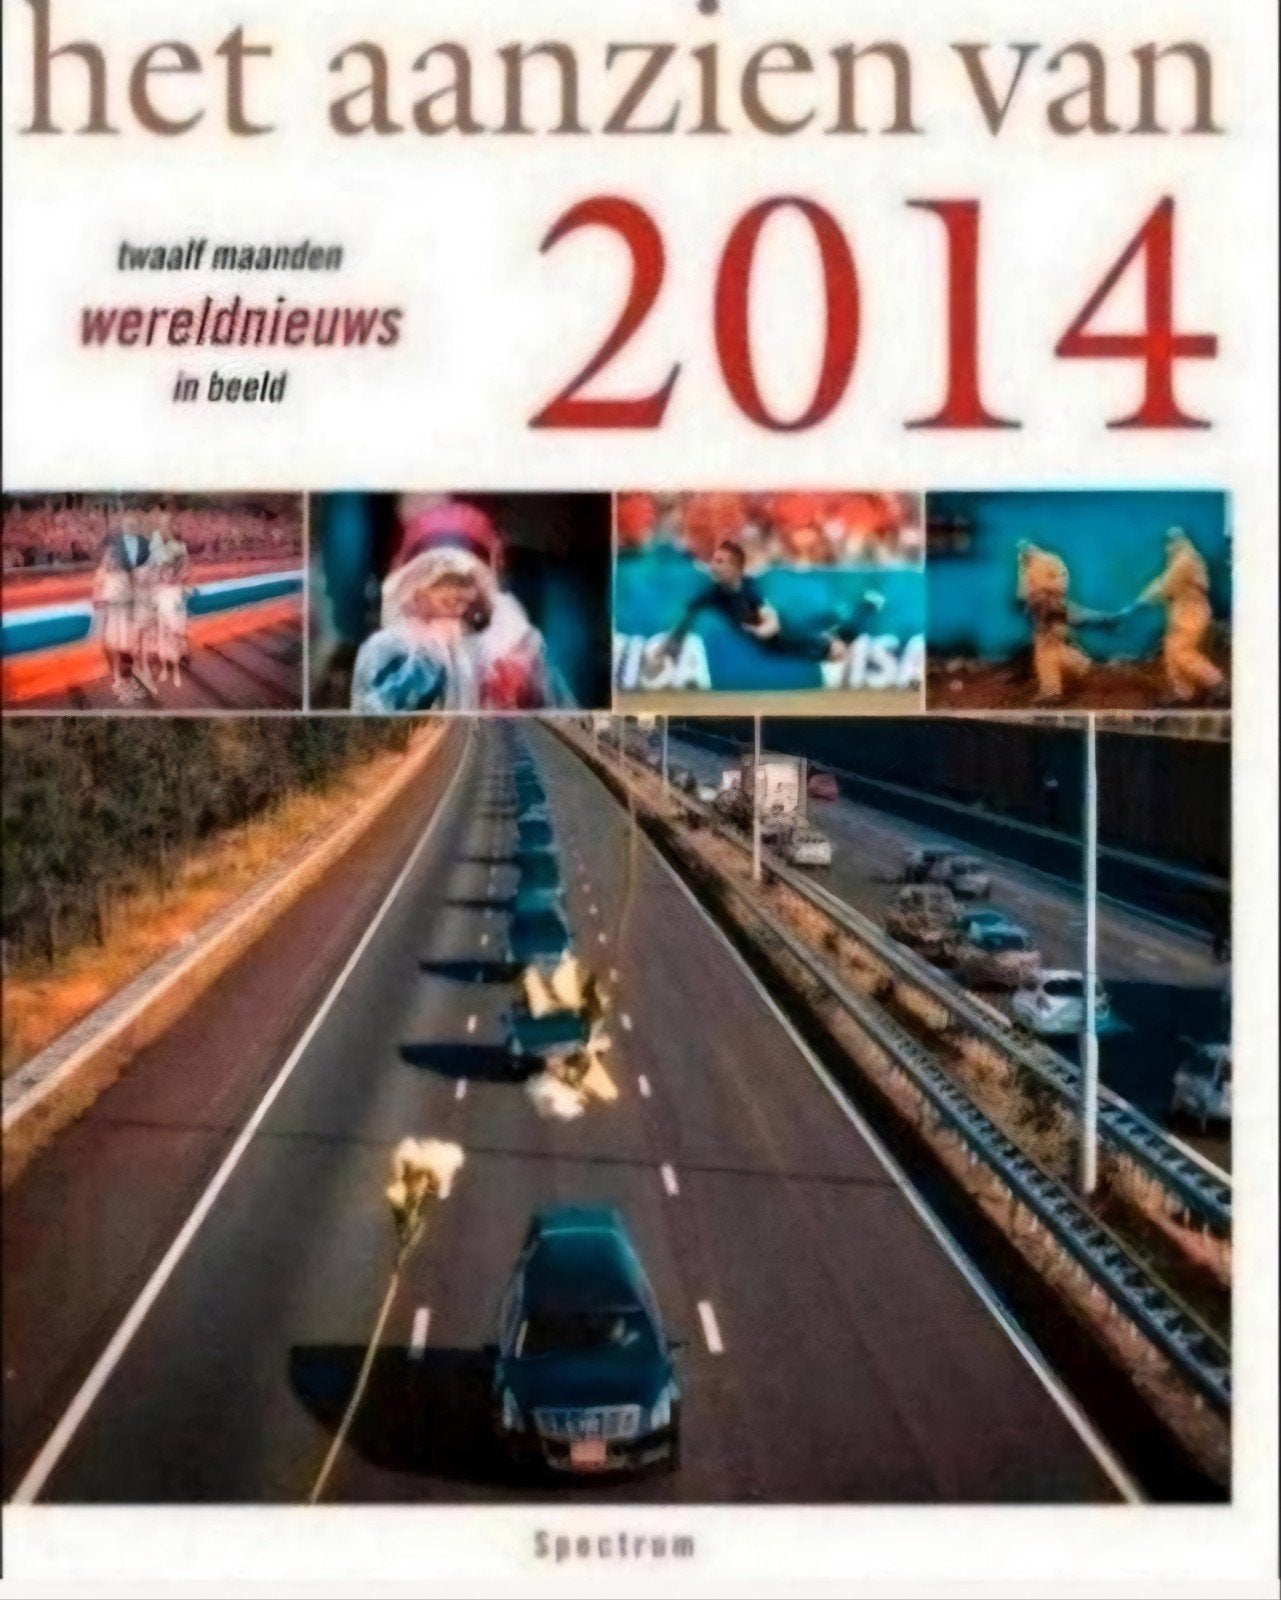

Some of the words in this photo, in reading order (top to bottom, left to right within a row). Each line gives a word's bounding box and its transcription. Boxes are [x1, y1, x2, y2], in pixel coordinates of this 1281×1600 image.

[18, 0, 275, 136] het
[327, 0, 925, 136] aanzien
[951, 40, 1226, 137] van
[117, 238, 207, 271] twaalf
[212, 238, 344, 271] maanden
[80, 295, 404, 347] wereldnieuws
[527, 194, 1219, 432] 2014
[173, 370, 198, 403] in
[208, 371, 288, 403] beeld
[534, 1529, 695, 1563] Spectrum
